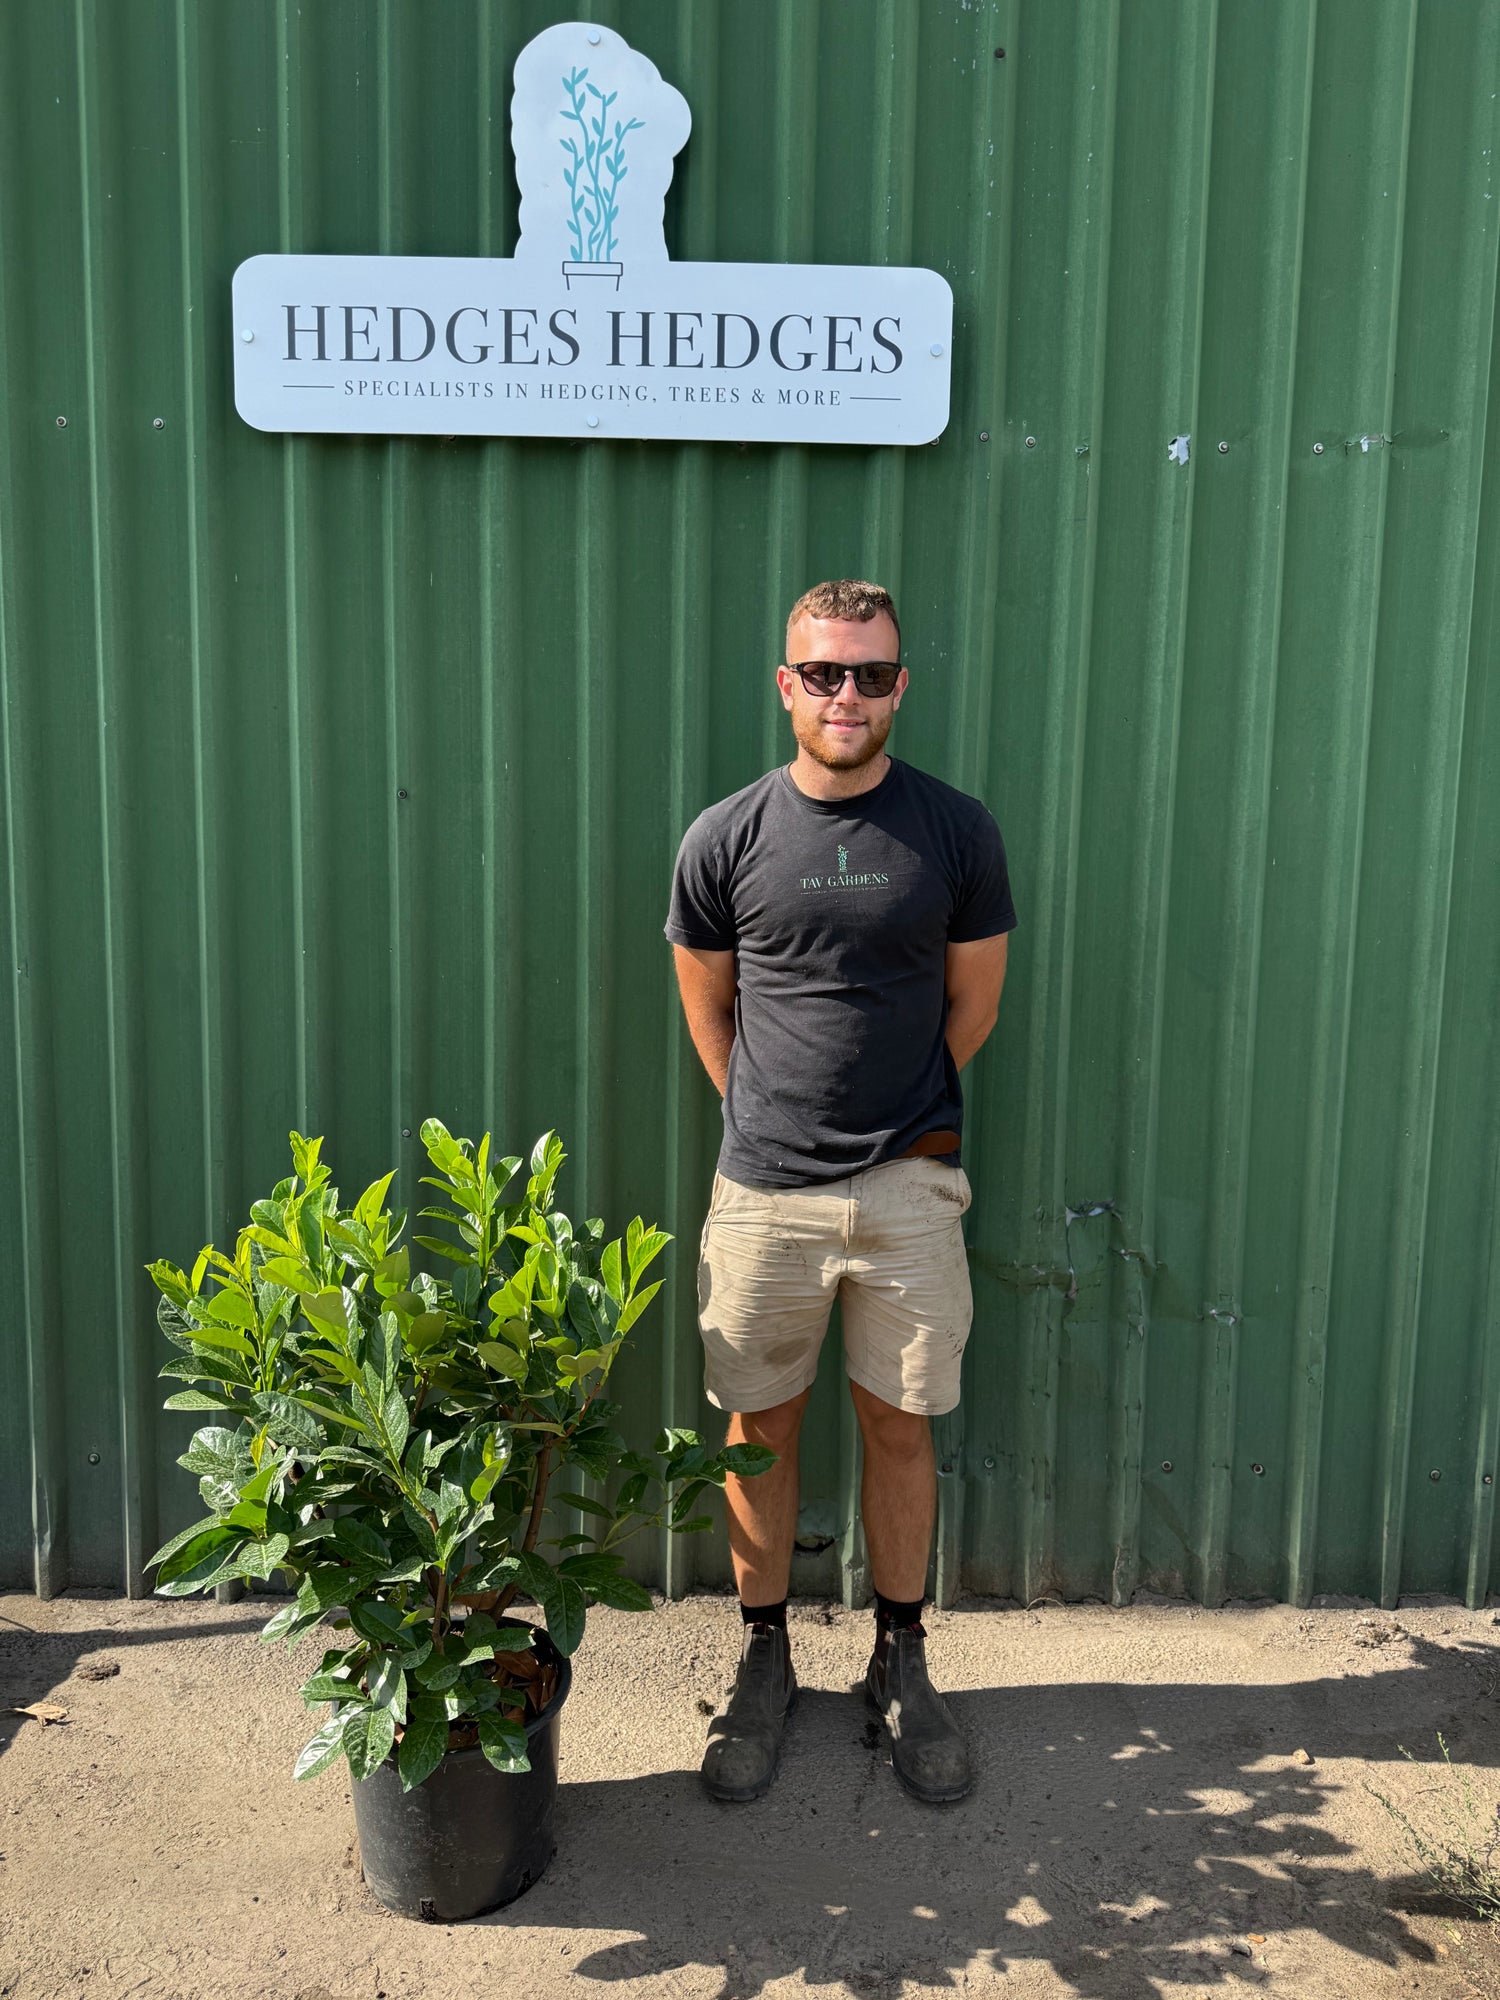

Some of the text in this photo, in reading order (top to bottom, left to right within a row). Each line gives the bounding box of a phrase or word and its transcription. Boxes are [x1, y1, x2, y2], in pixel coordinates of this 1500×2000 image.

[281, 305, 903, 374] HEDGES HEDGES
[344, 380, 841, 406] SPECIALISTS IN HEDGING, TREES & MORE
[800, 873, 888, 889] TAV GARDENS
